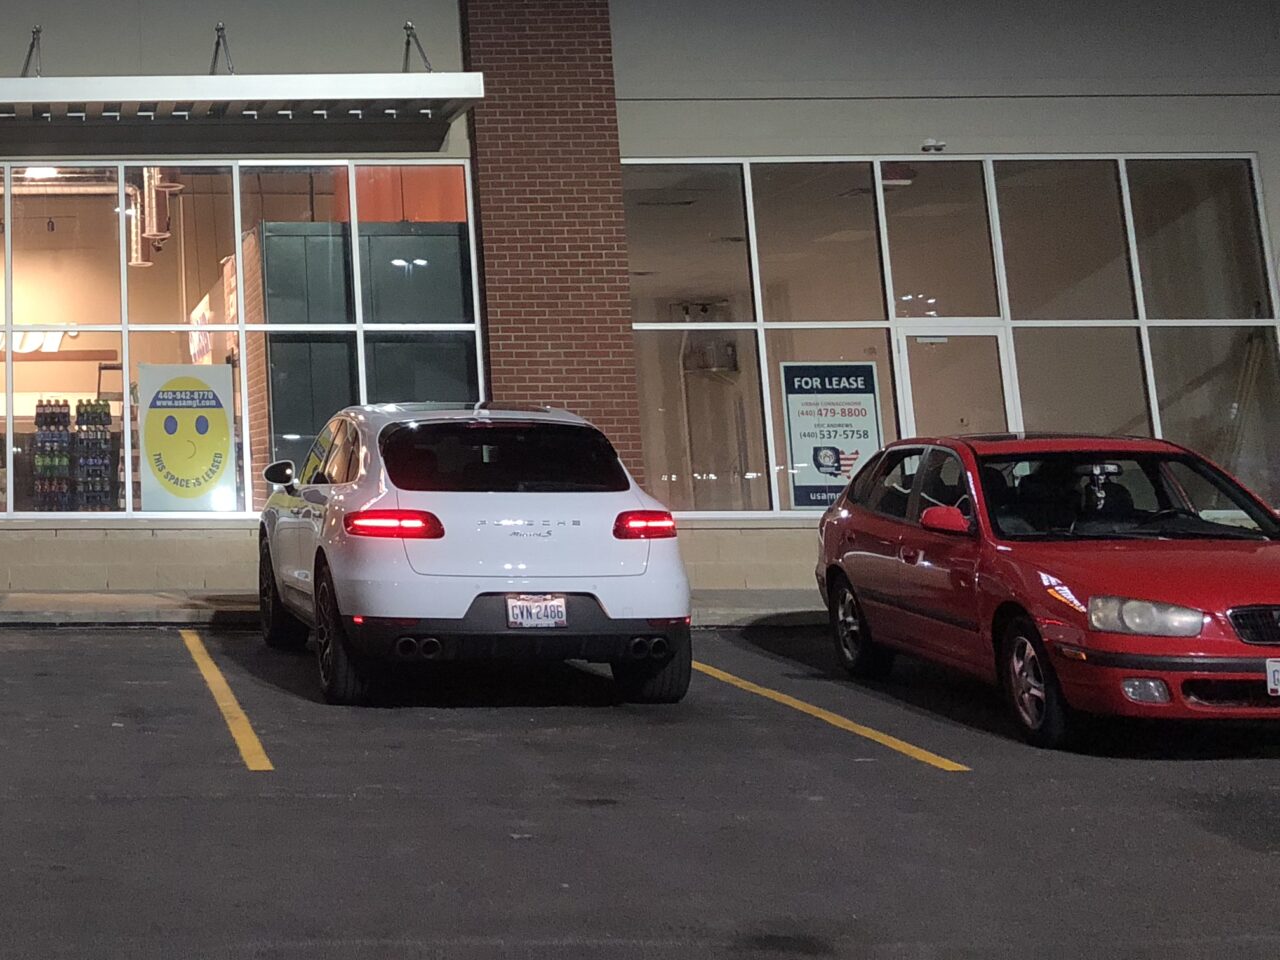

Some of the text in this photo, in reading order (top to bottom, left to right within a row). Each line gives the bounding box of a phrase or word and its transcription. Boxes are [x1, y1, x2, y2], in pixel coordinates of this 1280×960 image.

[793, 376, 865, 389] FOR LEASE
[817, 408, 867, 417] 479-8800
[819, 430, 869, 439] 537-5758
[153, 452, 222, 488] THIS SPACE IS LEASED
[511, 604, 564, 620] GVN 2486
